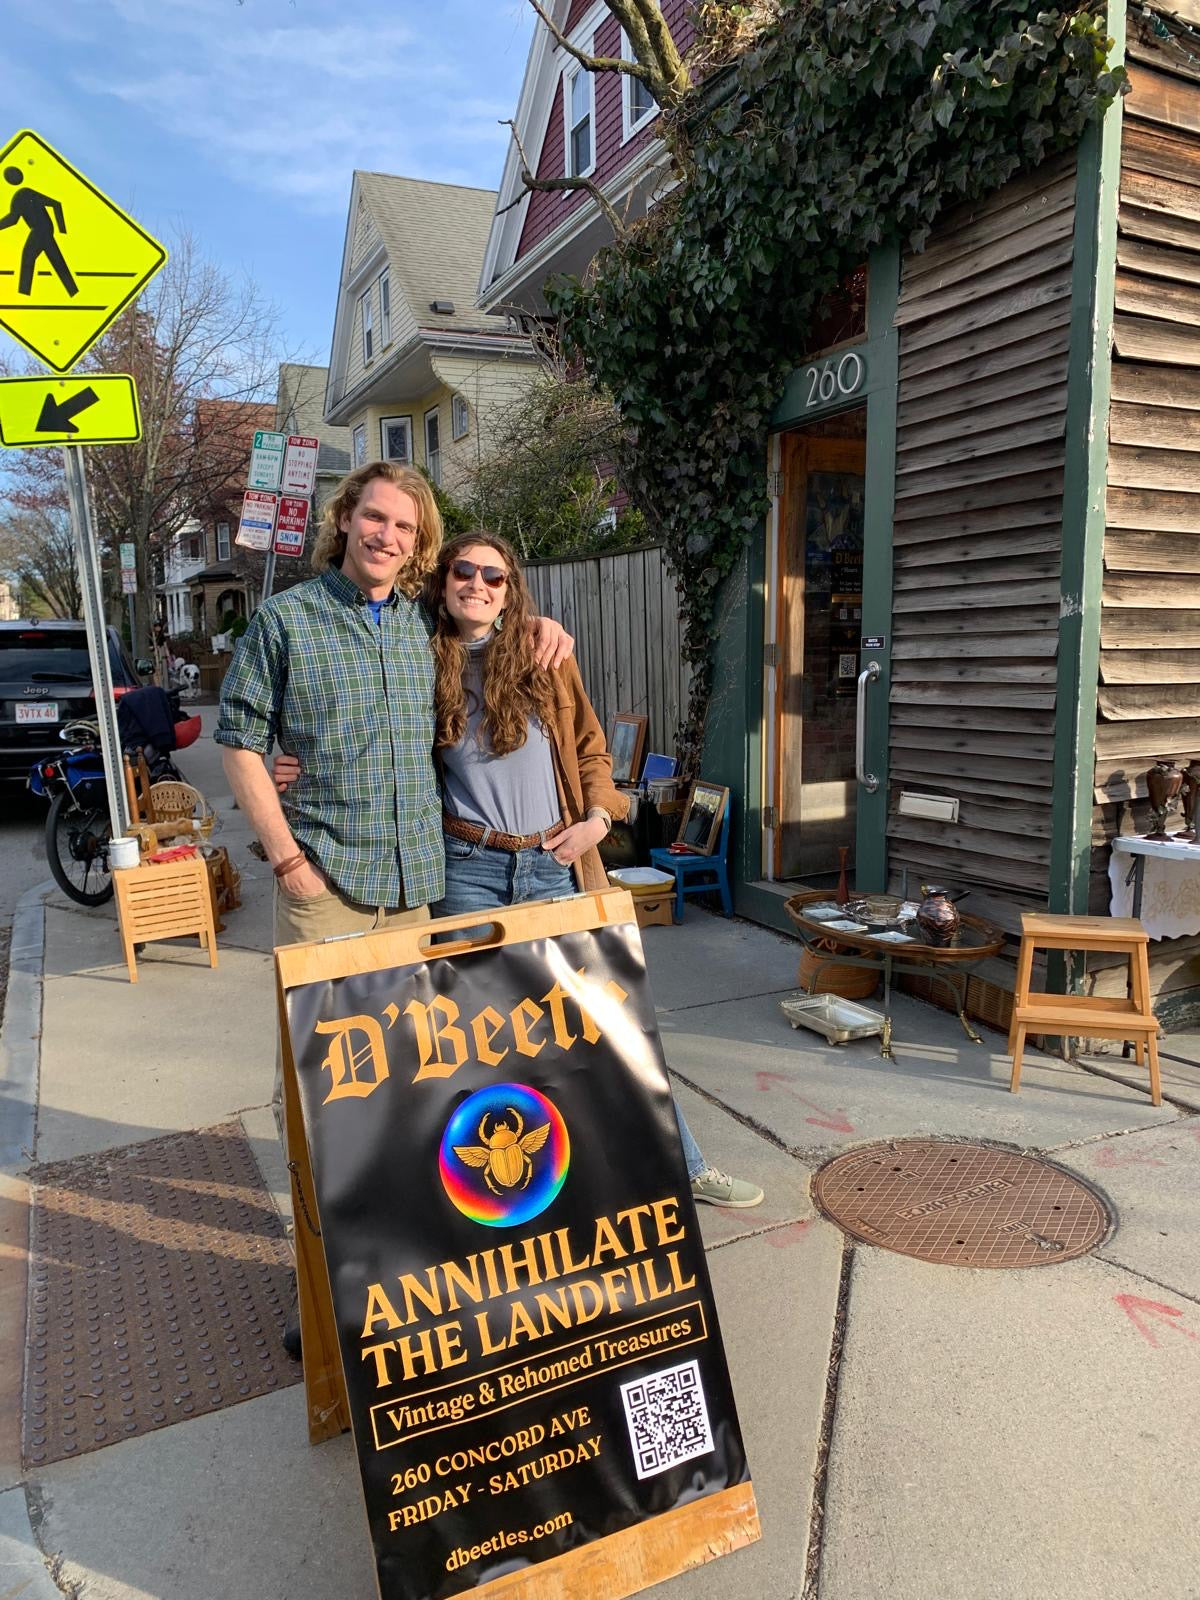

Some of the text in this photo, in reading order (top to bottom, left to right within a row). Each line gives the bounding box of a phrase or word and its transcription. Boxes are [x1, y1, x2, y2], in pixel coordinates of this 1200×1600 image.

[805, 352, 862, 407] 260
[255, 434, 262, 447] 2
[290, 437, 317, 447] TOW ZONE
[288, 459, 312, 469] STOPPING
[288, 470, 310, 480] ANYTIME
[248, 492, 274, 503] TOW ZONE
[288, 507, 298, 517] NO
[279, 515, 305, 527] PARKING
[280, 531, 300, 543] SNOW
[277, 544, 299, 553] EMERGENCY
[24, 686, 49, 694] Jeep
[18, 707, 42, 719] 3VTX
[360, 1197, 686, 1338] ANNIHILATE
[361, 1252, 697, 1389] THE LANDFILL
[386, 1318, 692, 1431] Vintage & Rehomed Treasures
[390, 1406, 592, 1495] 260 CONCORD AVE
[388, 1483, 472, 1531] FRIDAY
[490, 1436, 603, 1495] SATURDAY
[445, 1510, 574, 1572] dbeetles.com
